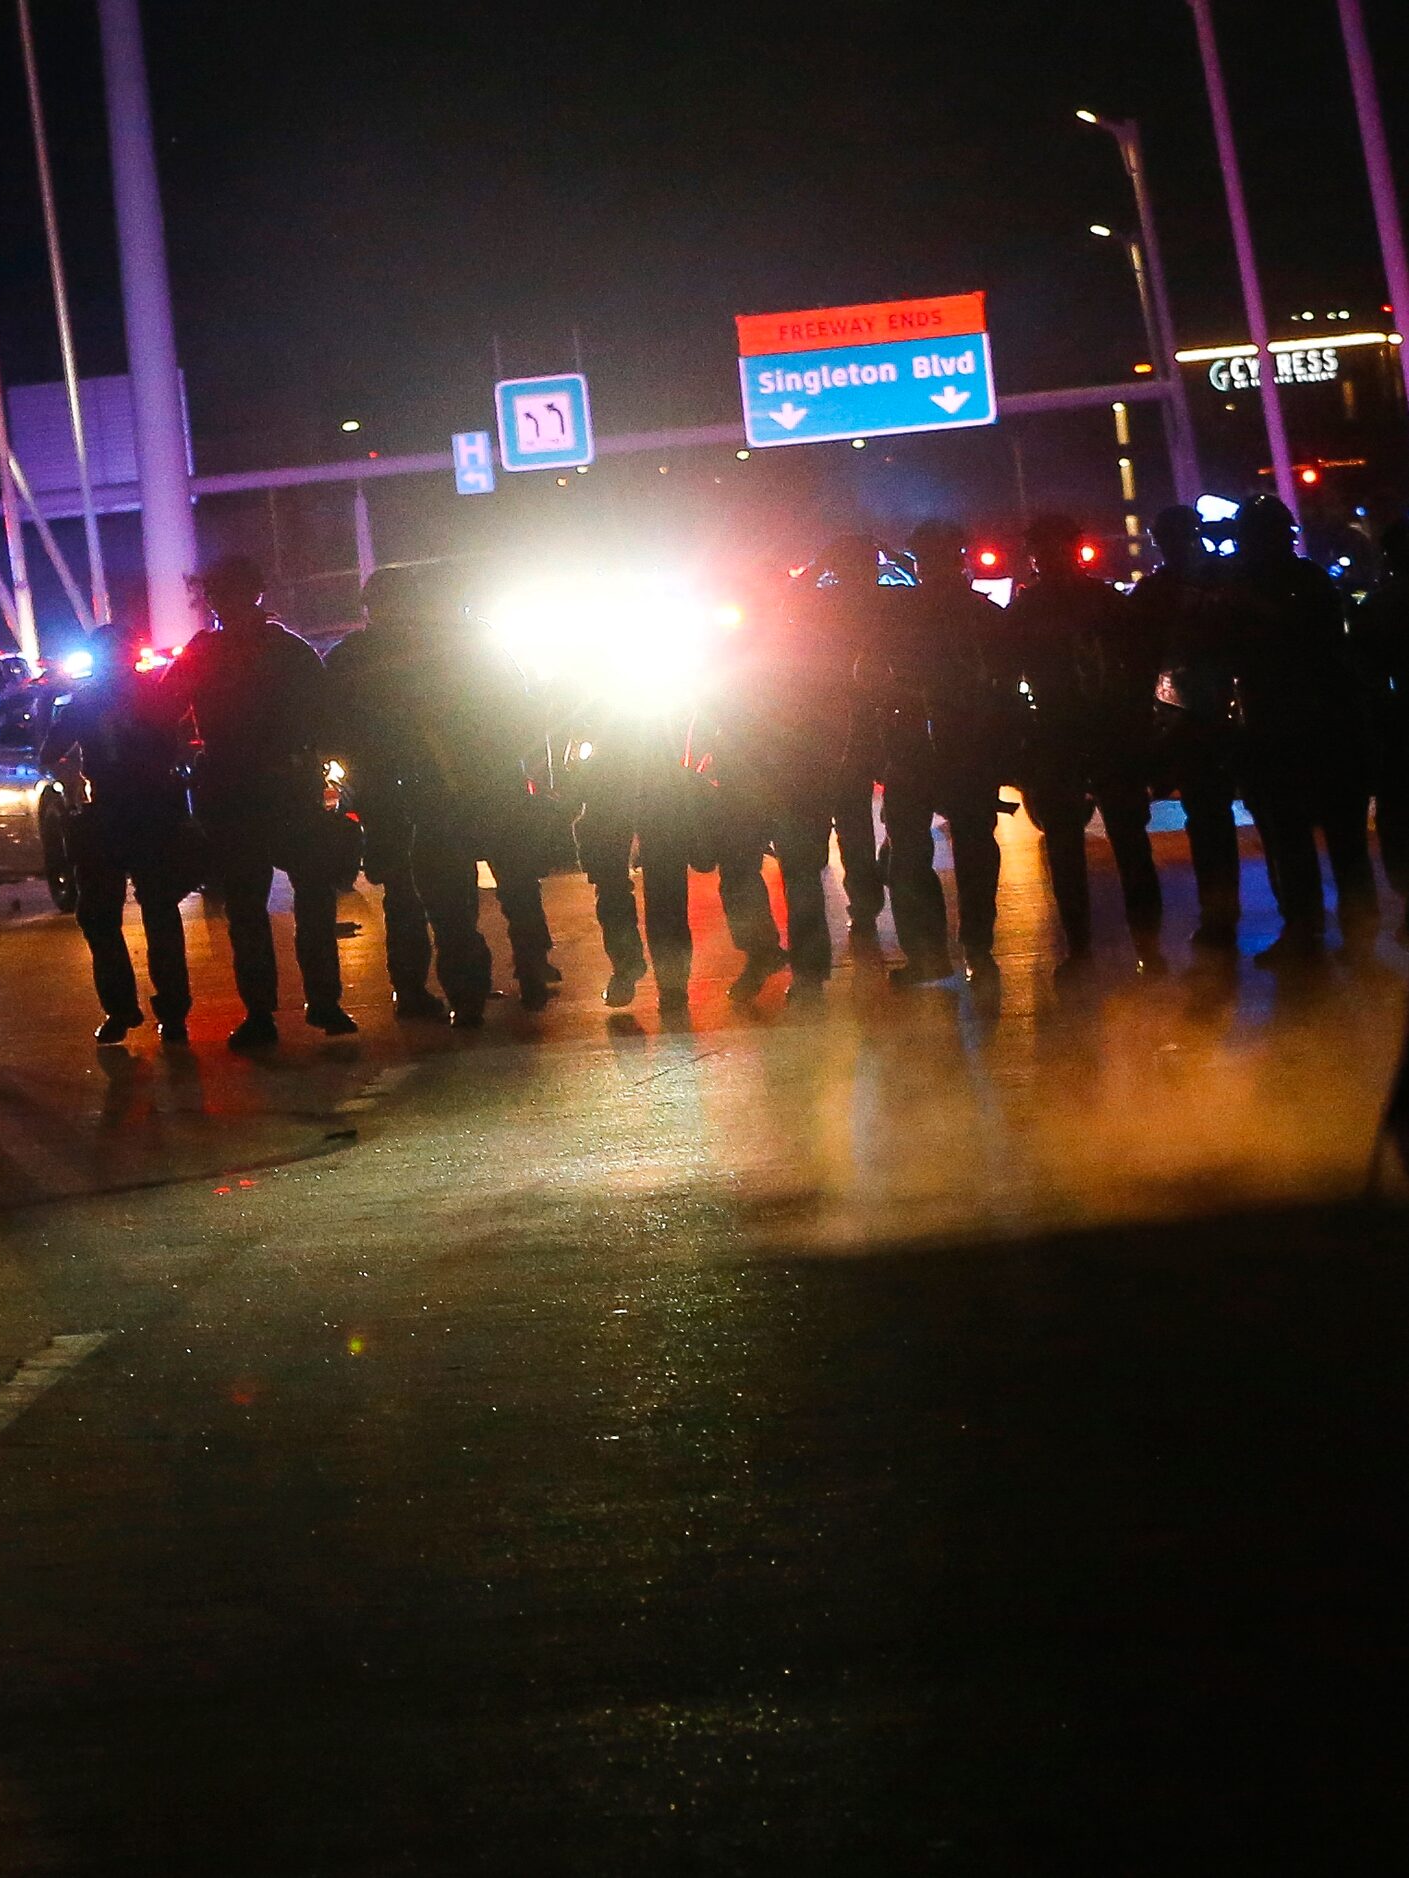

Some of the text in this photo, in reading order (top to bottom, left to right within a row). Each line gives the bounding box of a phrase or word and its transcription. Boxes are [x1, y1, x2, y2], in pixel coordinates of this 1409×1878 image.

[779, 310, 943, 341] FREEWAY ENDS
[758, 350, 975, 395] Singleton Blvd
[1230, 348, 1339, 382] CYRESS
[458, 433, 487, 467] H
